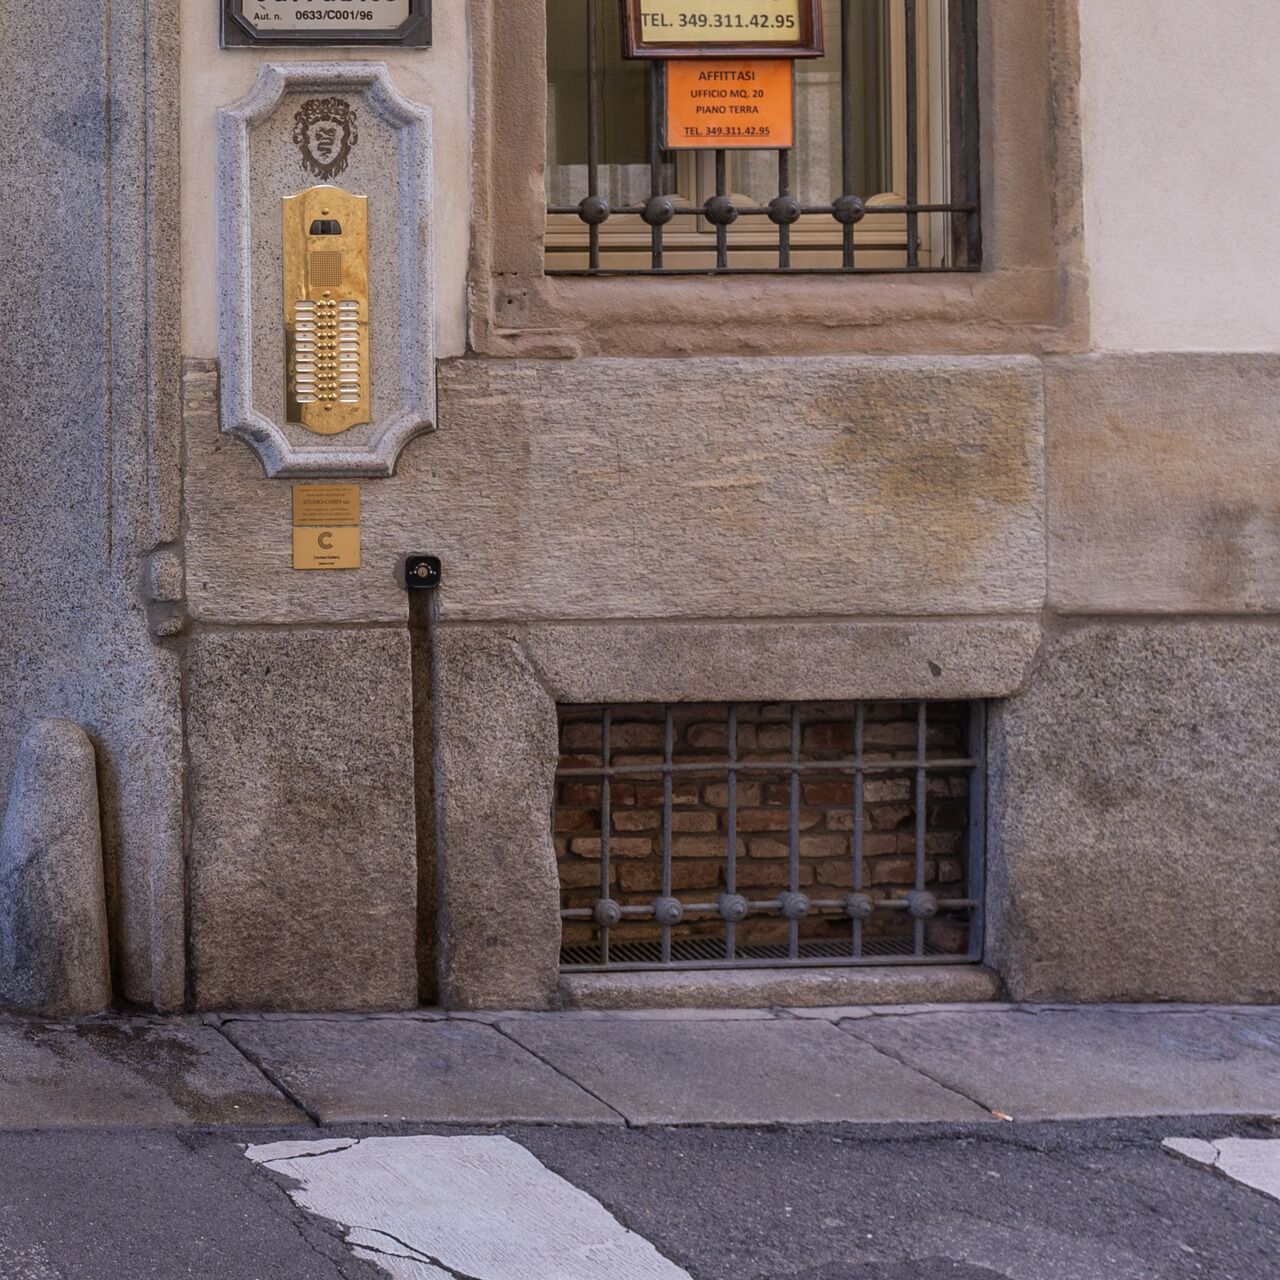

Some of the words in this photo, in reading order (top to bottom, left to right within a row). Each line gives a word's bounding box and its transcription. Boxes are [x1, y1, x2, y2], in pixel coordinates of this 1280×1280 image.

[253, 12, 271, 21] Aut.
[295, 10, 373, 21] 0633/C001/96
[641, 13, 673, 27] TEL.
[678, 13, 795, 29] 349.311.42.95
[698, 71, 755, 81] AFFITTASI
[690, 89, 727, 98] UFFICIO
[729, 89, 750, 99] MQ.
[752, 89, 764, 98] 20
[696, 105, 726, 114] PIANO
[729, 105, 759, 114] TERRA
[684, 127, 702, 136] TEL.
[705, 126, 770, 136] 349.311.42.95
[317, 531, 333, 550] C
